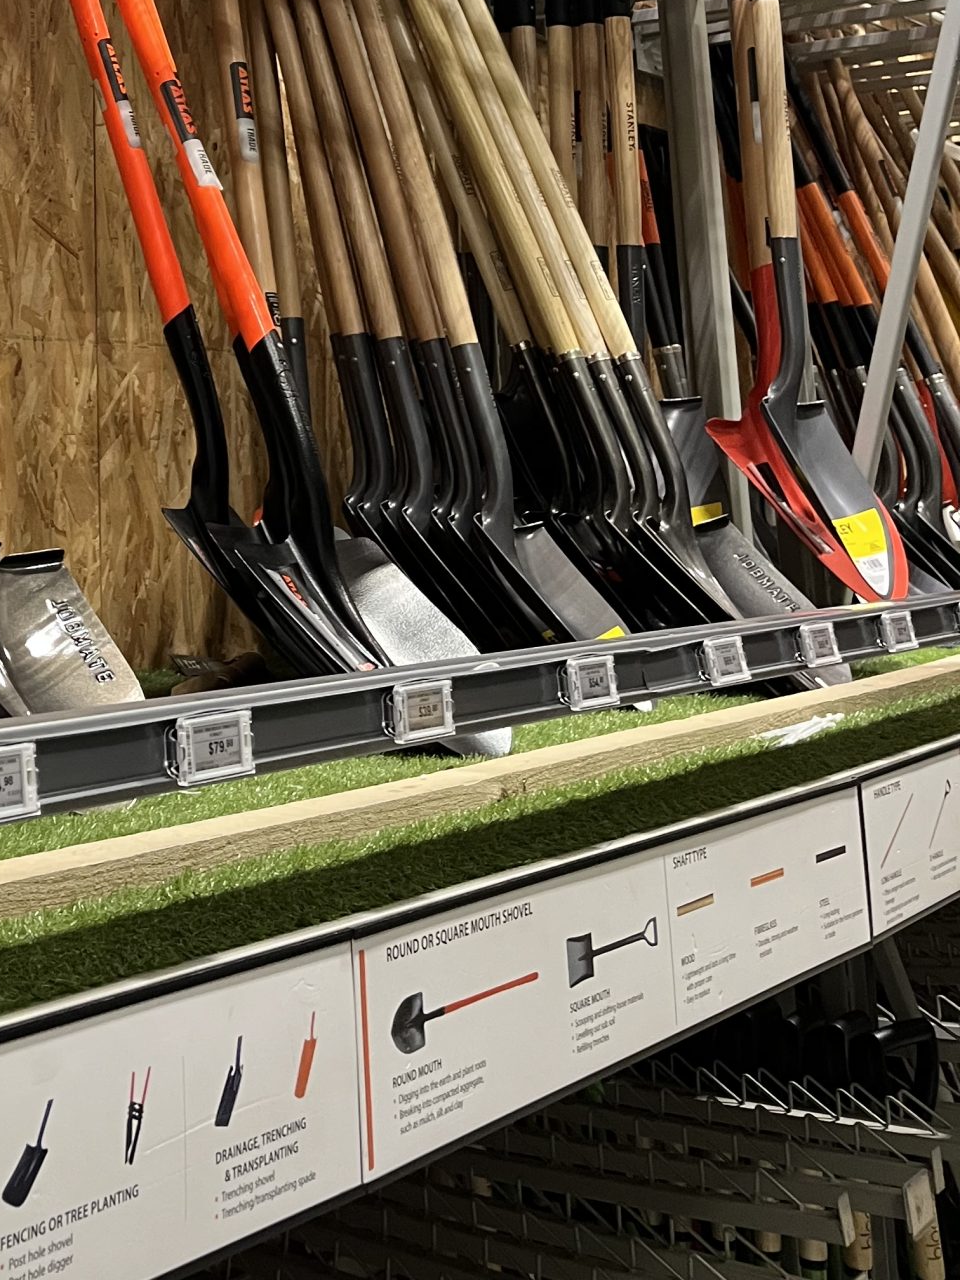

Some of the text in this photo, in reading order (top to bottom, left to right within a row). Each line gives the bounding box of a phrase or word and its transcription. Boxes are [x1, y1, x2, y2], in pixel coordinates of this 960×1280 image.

[169, 84, 198, 134] ATLAS
[238, 67, 253, 114] ATLAS
[247, 127, 257, 153] TRADE
[625, 102, 636, 150] STANLEY
[197, 149, 212, 175] TRADE
[736, 553, 802, 612] JOBMATE
[50, 599, 115, 684] JOBMATE
[673, 846, 707, 869] SHAFT TYPE
[386, 902, 533, 962] ROUND OR SQUARE MOUTH SHOVEL
[681, 953, 695, 966] WOOD
[570, 987, 610, 1013] SQUARE MOUTH
[392, 1058, 442, 1089] ROUND MOUTH
[398, 1089, 419, 1105] Digging
[419, 1084, 430, 1095] into
[430, 1080, 438, 1090] the
[438, 1074, 451, 1087] earth
[452, 1068, 461, 1081] and
[462, 1064, 474, 1078] plant
[400, 1104, 422, 1120] Breaking
[422, 1098, 433, 1109] into
[432, 1084, 460, 1105] compacted
[400, 1121, 412, 1136] such
[436, 1106, 444, 1119] silt
[444, 1101, 454, 1114] and
[454, 1099, 464, 1111] clay
[215, 1117, 307, 1165] DRAINAGE, TRENCHING
[224, 1140, 299, 1182] & TRANSPLANTING
[298, 1170, 316, 1188] spade
[221, 1169, 276, 1202] Trenching shovel
[0, 1184, 139, 1252] FENCING OR TREE PLANTING
[8, 1233, 74, 1271] Post hole shovel
[27, 1265, 46, 1280] hole
[47, 1253, 74, 1273] digger
